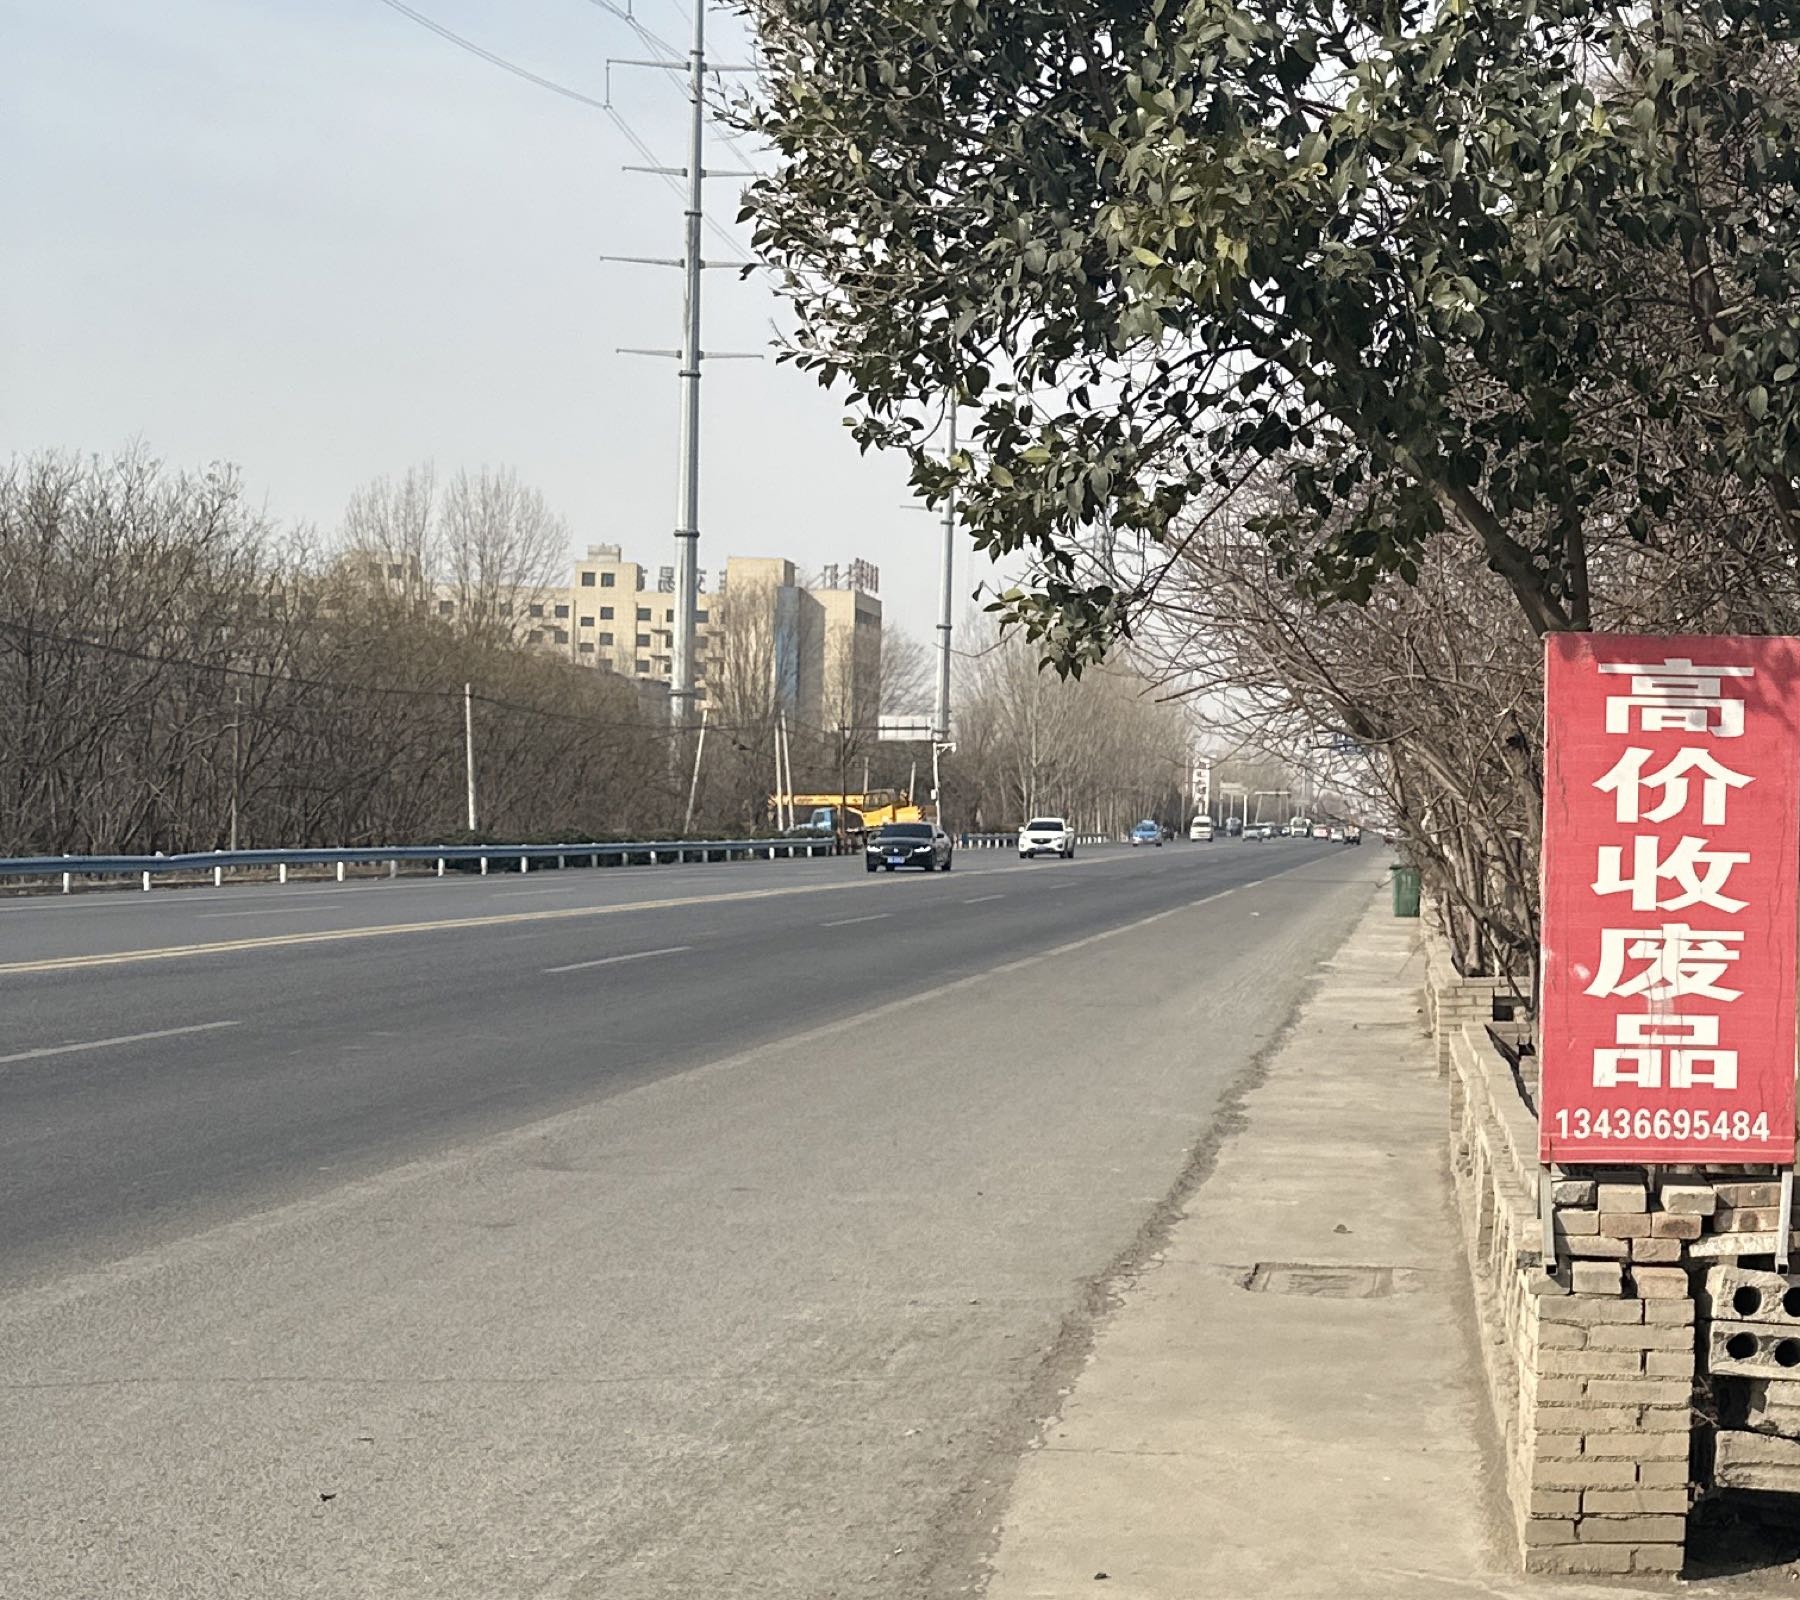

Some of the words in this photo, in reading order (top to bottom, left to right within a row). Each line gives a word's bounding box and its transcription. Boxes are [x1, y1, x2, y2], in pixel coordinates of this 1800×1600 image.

[1584, 657, 1758, 1089] 高价收废品
[1555, 1109, 1771, 1143] 13436695484
